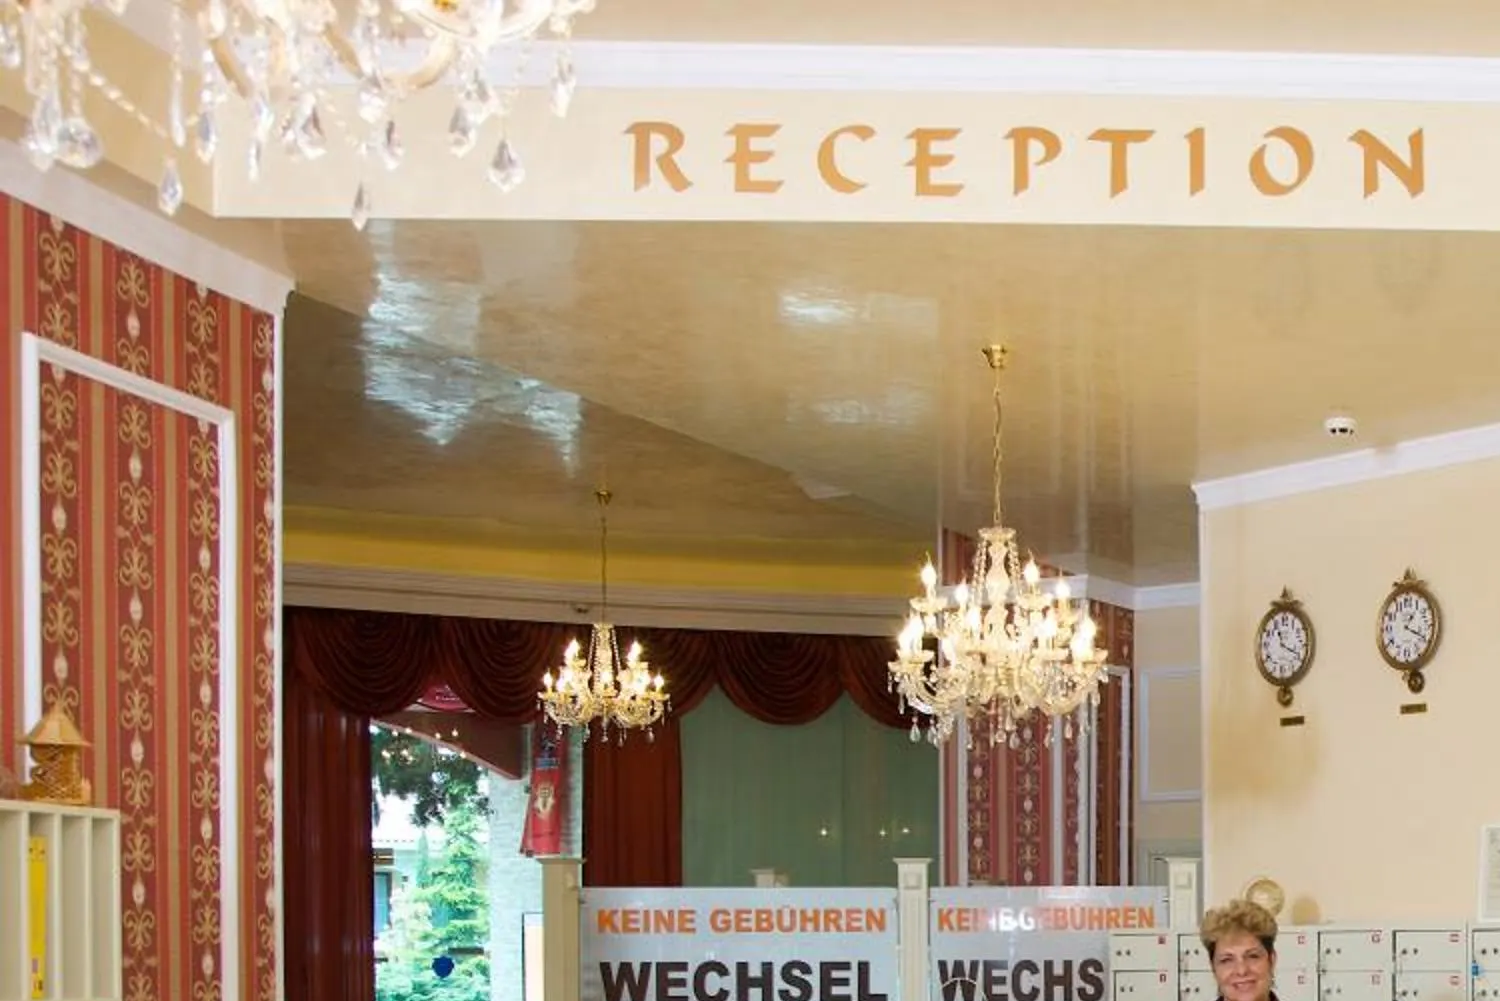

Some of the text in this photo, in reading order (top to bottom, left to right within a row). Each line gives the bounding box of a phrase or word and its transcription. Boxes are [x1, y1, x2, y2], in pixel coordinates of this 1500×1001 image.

[621, 121, 1425, 199] RECEPTION
[597, 902, 887, 934] KEINE GEBÜHREN
